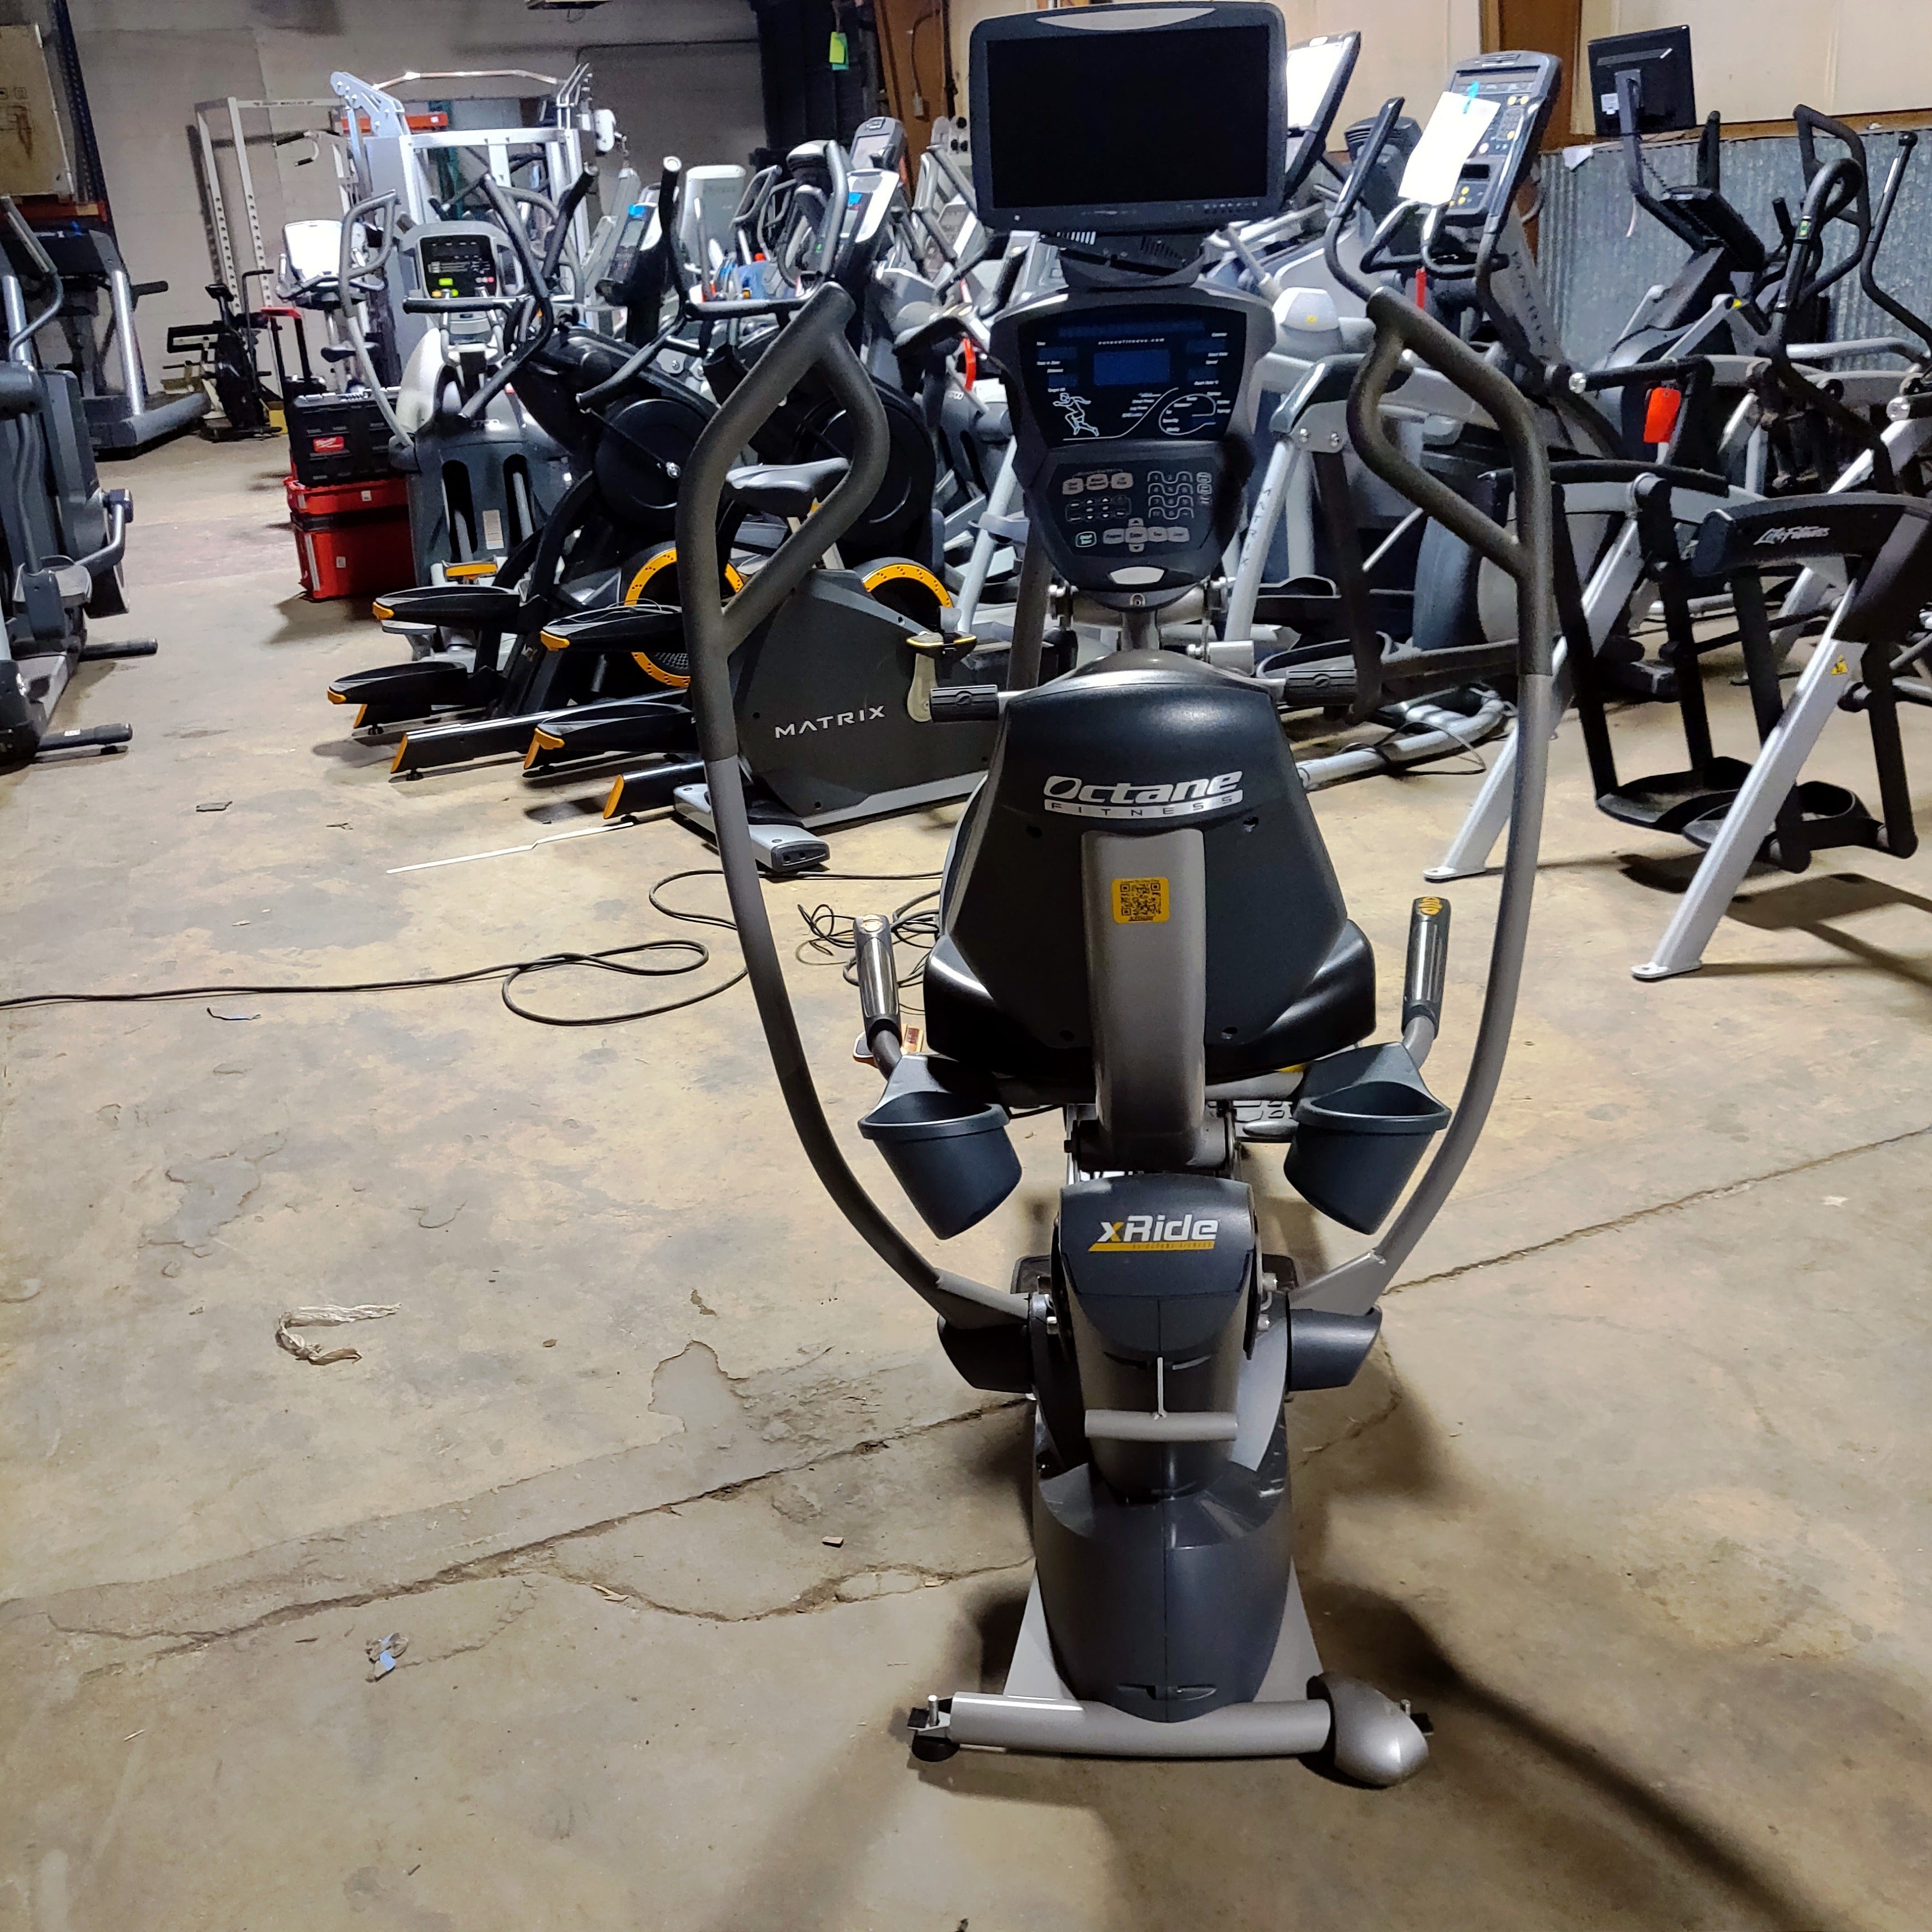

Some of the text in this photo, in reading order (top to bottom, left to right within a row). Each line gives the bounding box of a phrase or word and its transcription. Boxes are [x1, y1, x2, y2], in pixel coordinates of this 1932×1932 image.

[775, 705, 885, 738] MATRIX
[1044, 771, 1243, 804] Octane
[1051, 795, 1233, 817] FITNESS
[1097, 1214, 1219, 1242] xRide
